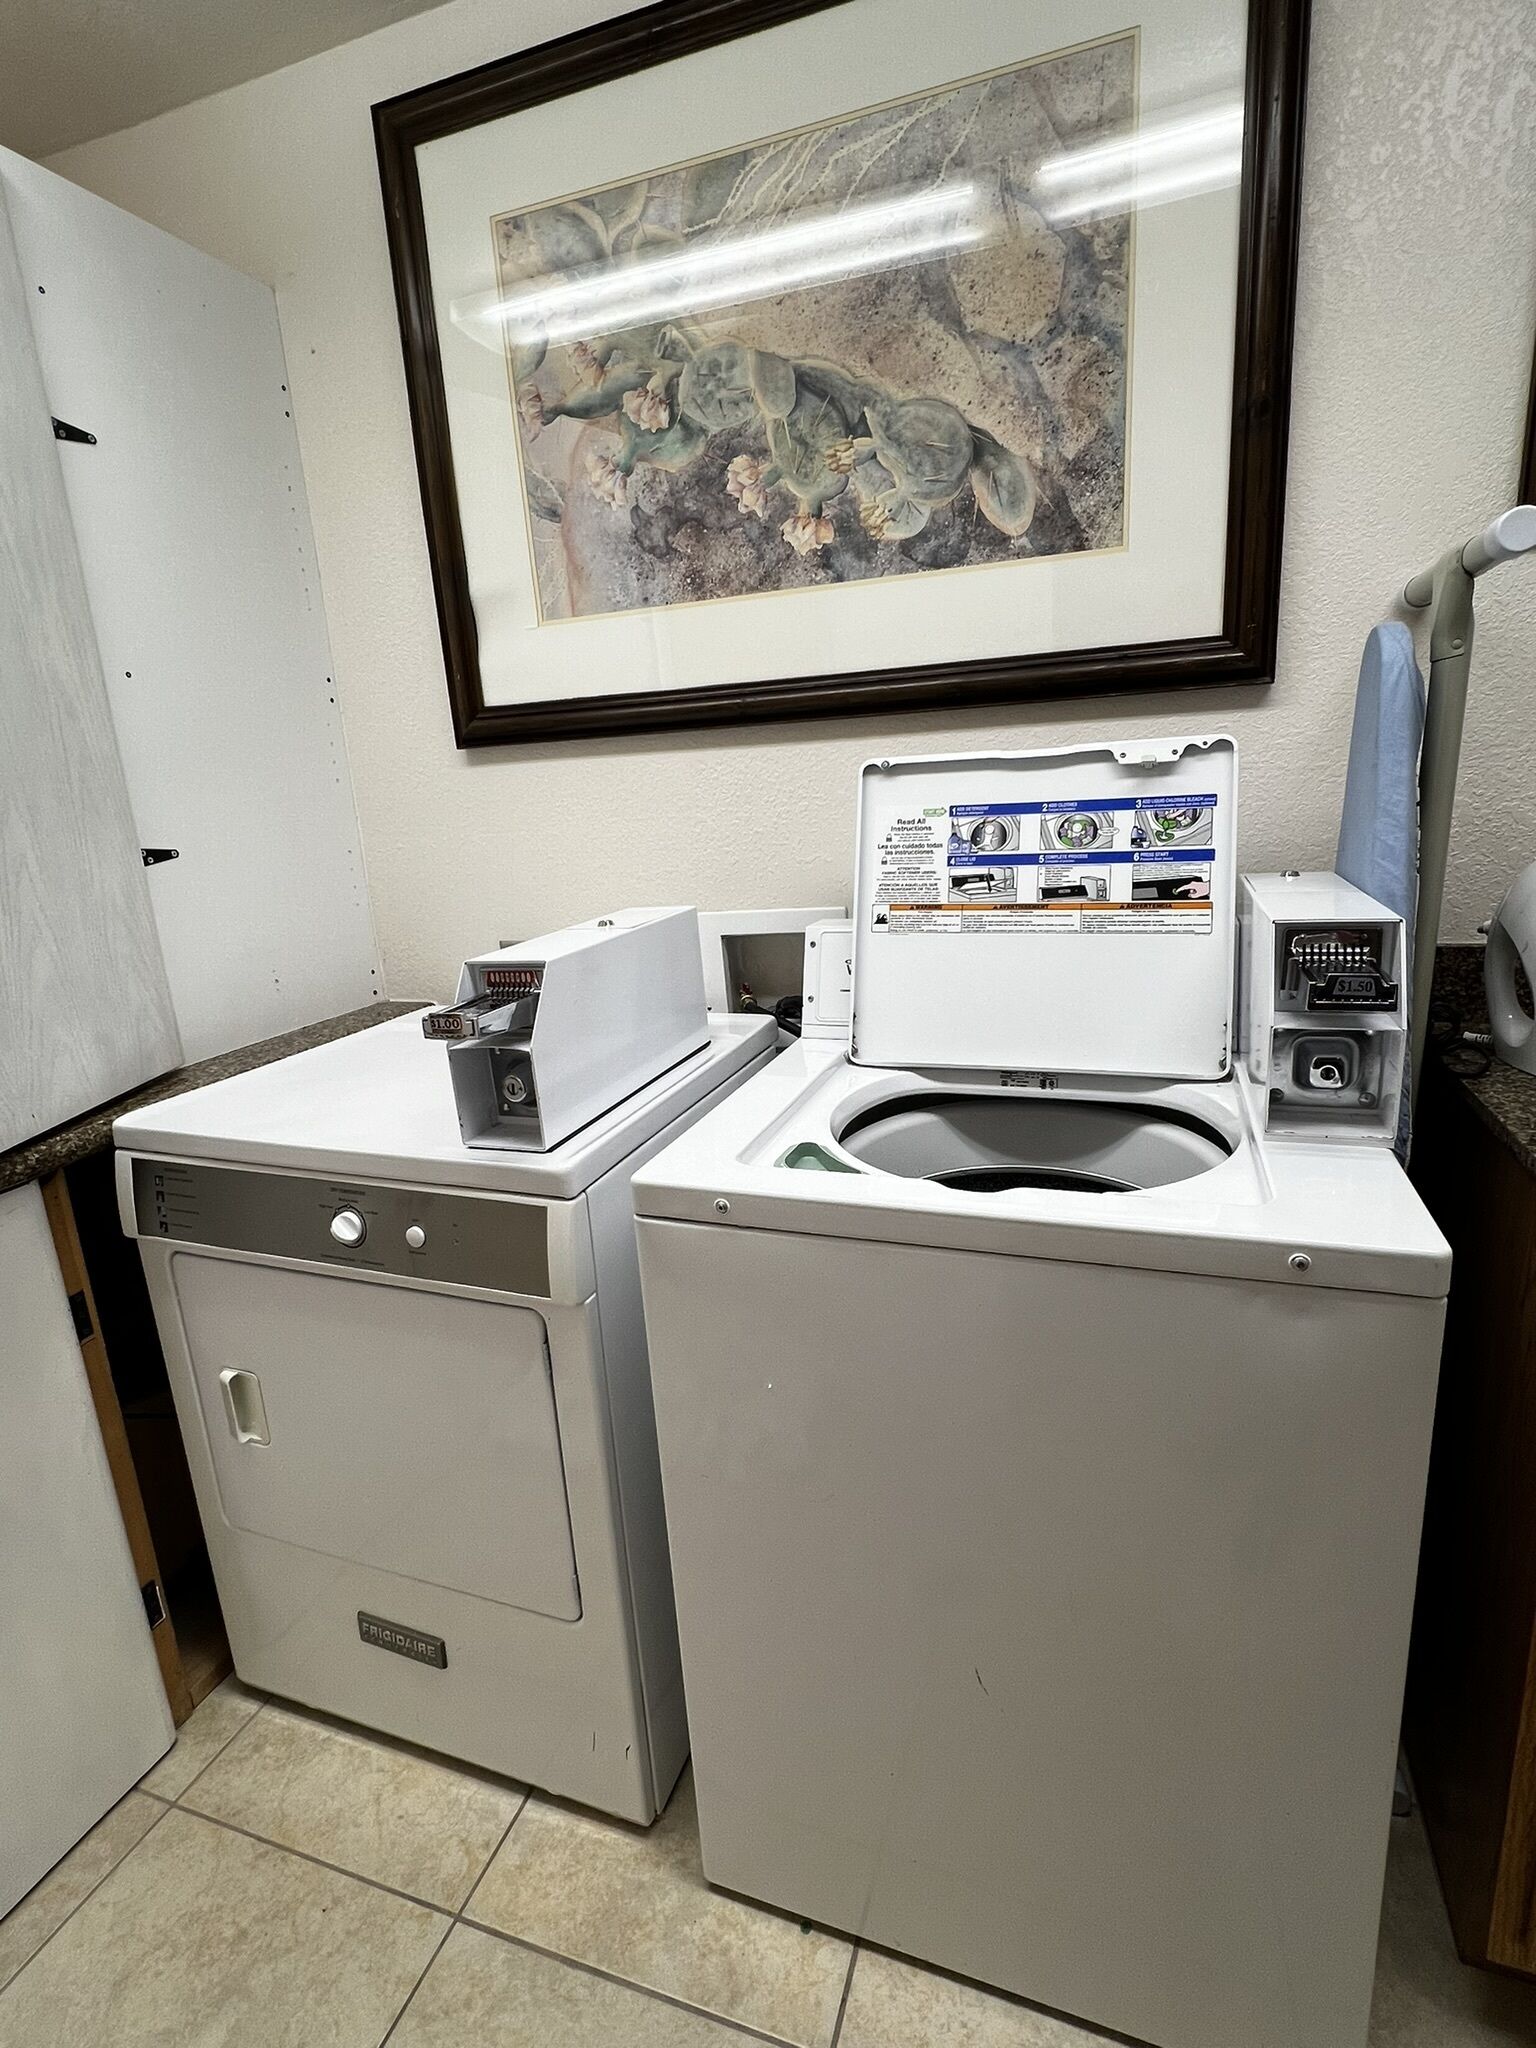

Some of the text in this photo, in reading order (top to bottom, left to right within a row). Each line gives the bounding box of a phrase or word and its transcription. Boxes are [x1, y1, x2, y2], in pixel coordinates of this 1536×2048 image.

[1042, 803, 1048, 812] 2
[1135, 799, 1141, 808] 3
[949, 857, 955, 865] 4
[1039, 854, 1044, 863] 5
[1133, 853, 1139, 861] 6
[1337, 980, 1373, 993] $1.50
[362, 1622, 436, 1658] FRIGIDAIRE
